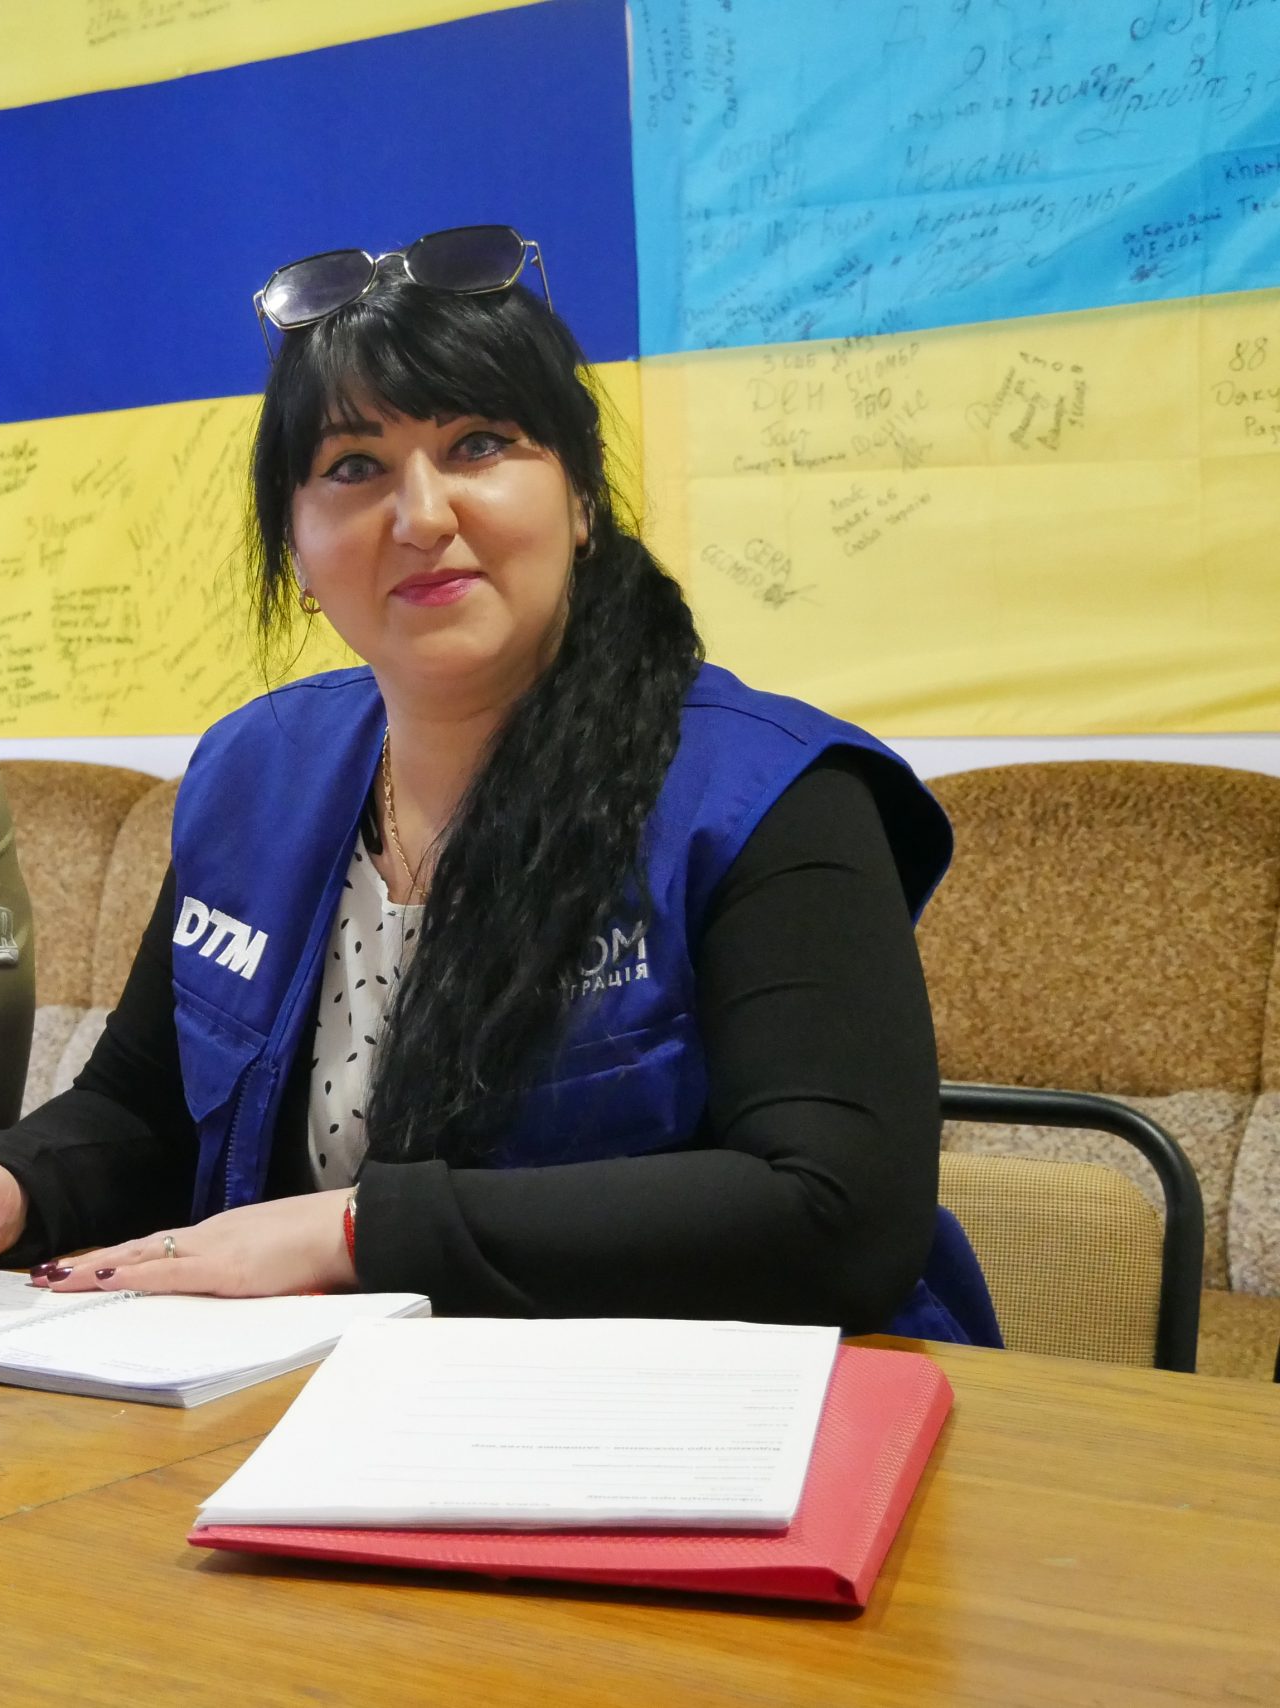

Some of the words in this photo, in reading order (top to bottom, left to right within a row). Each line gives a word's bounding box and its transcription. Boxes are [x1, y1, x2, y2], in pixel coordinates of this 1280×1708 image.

[173, 896, 268, 980] DTM
[580, 919, 647, 977] ОМ
[570, 962, 649, 1000] ГРАЦІЯ
